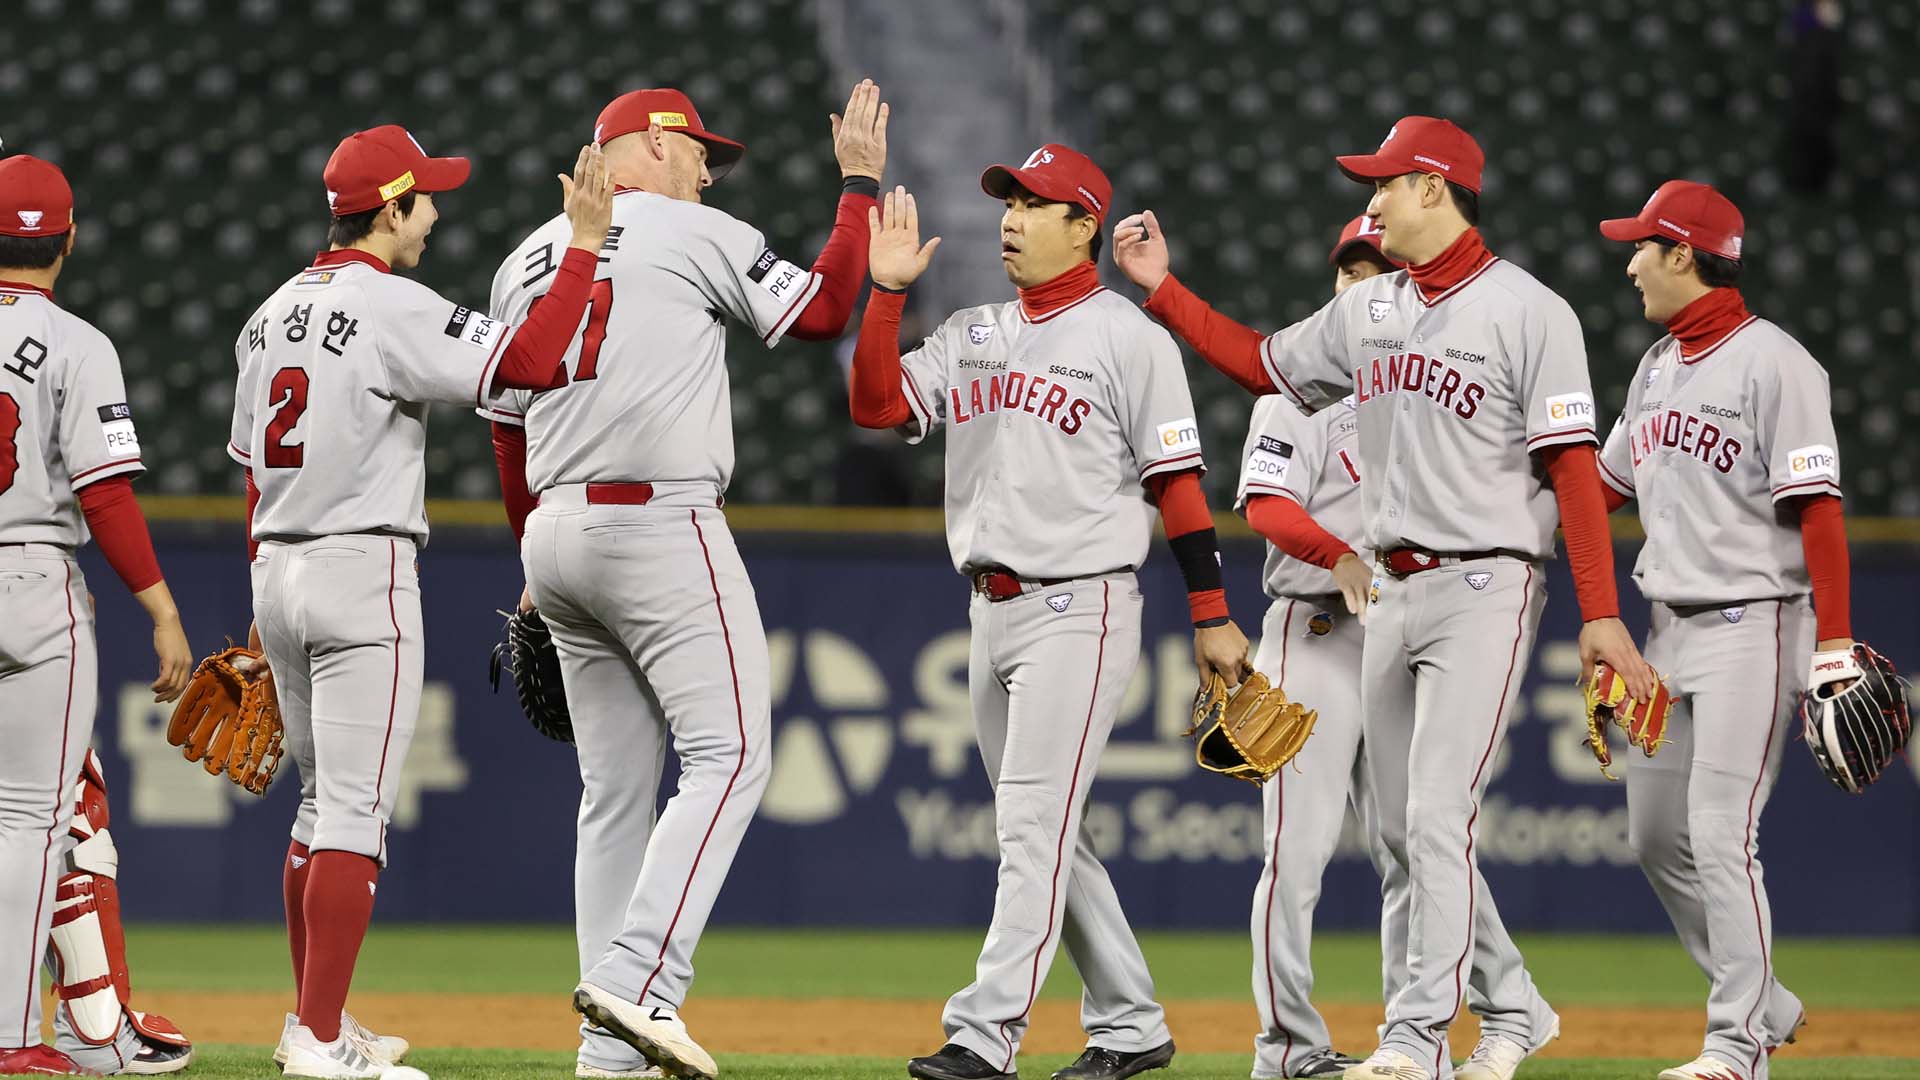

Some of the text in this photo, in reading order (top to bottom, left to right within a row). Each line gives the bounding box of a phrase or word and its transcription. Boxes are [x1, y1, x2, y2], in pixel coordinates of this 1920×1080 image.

[249, 302, 359, 358] 박성한
[527, 277, 614, 394] 7
[1361, 337, 1405, 351] SHINSEGAE
[1444, 348, 1486, 366] SSG.COM
[1048, 364, 1094, 383] SSG.COM
[1356, 352, 1486, 421] LANDERS
[264, 366, 310, 469] 2
[948, 371, 1093, 437] LANDERS
[1700, 403, 1742, 421] SSG.COM
[1630, 410, 1742, 475] LANDERS
